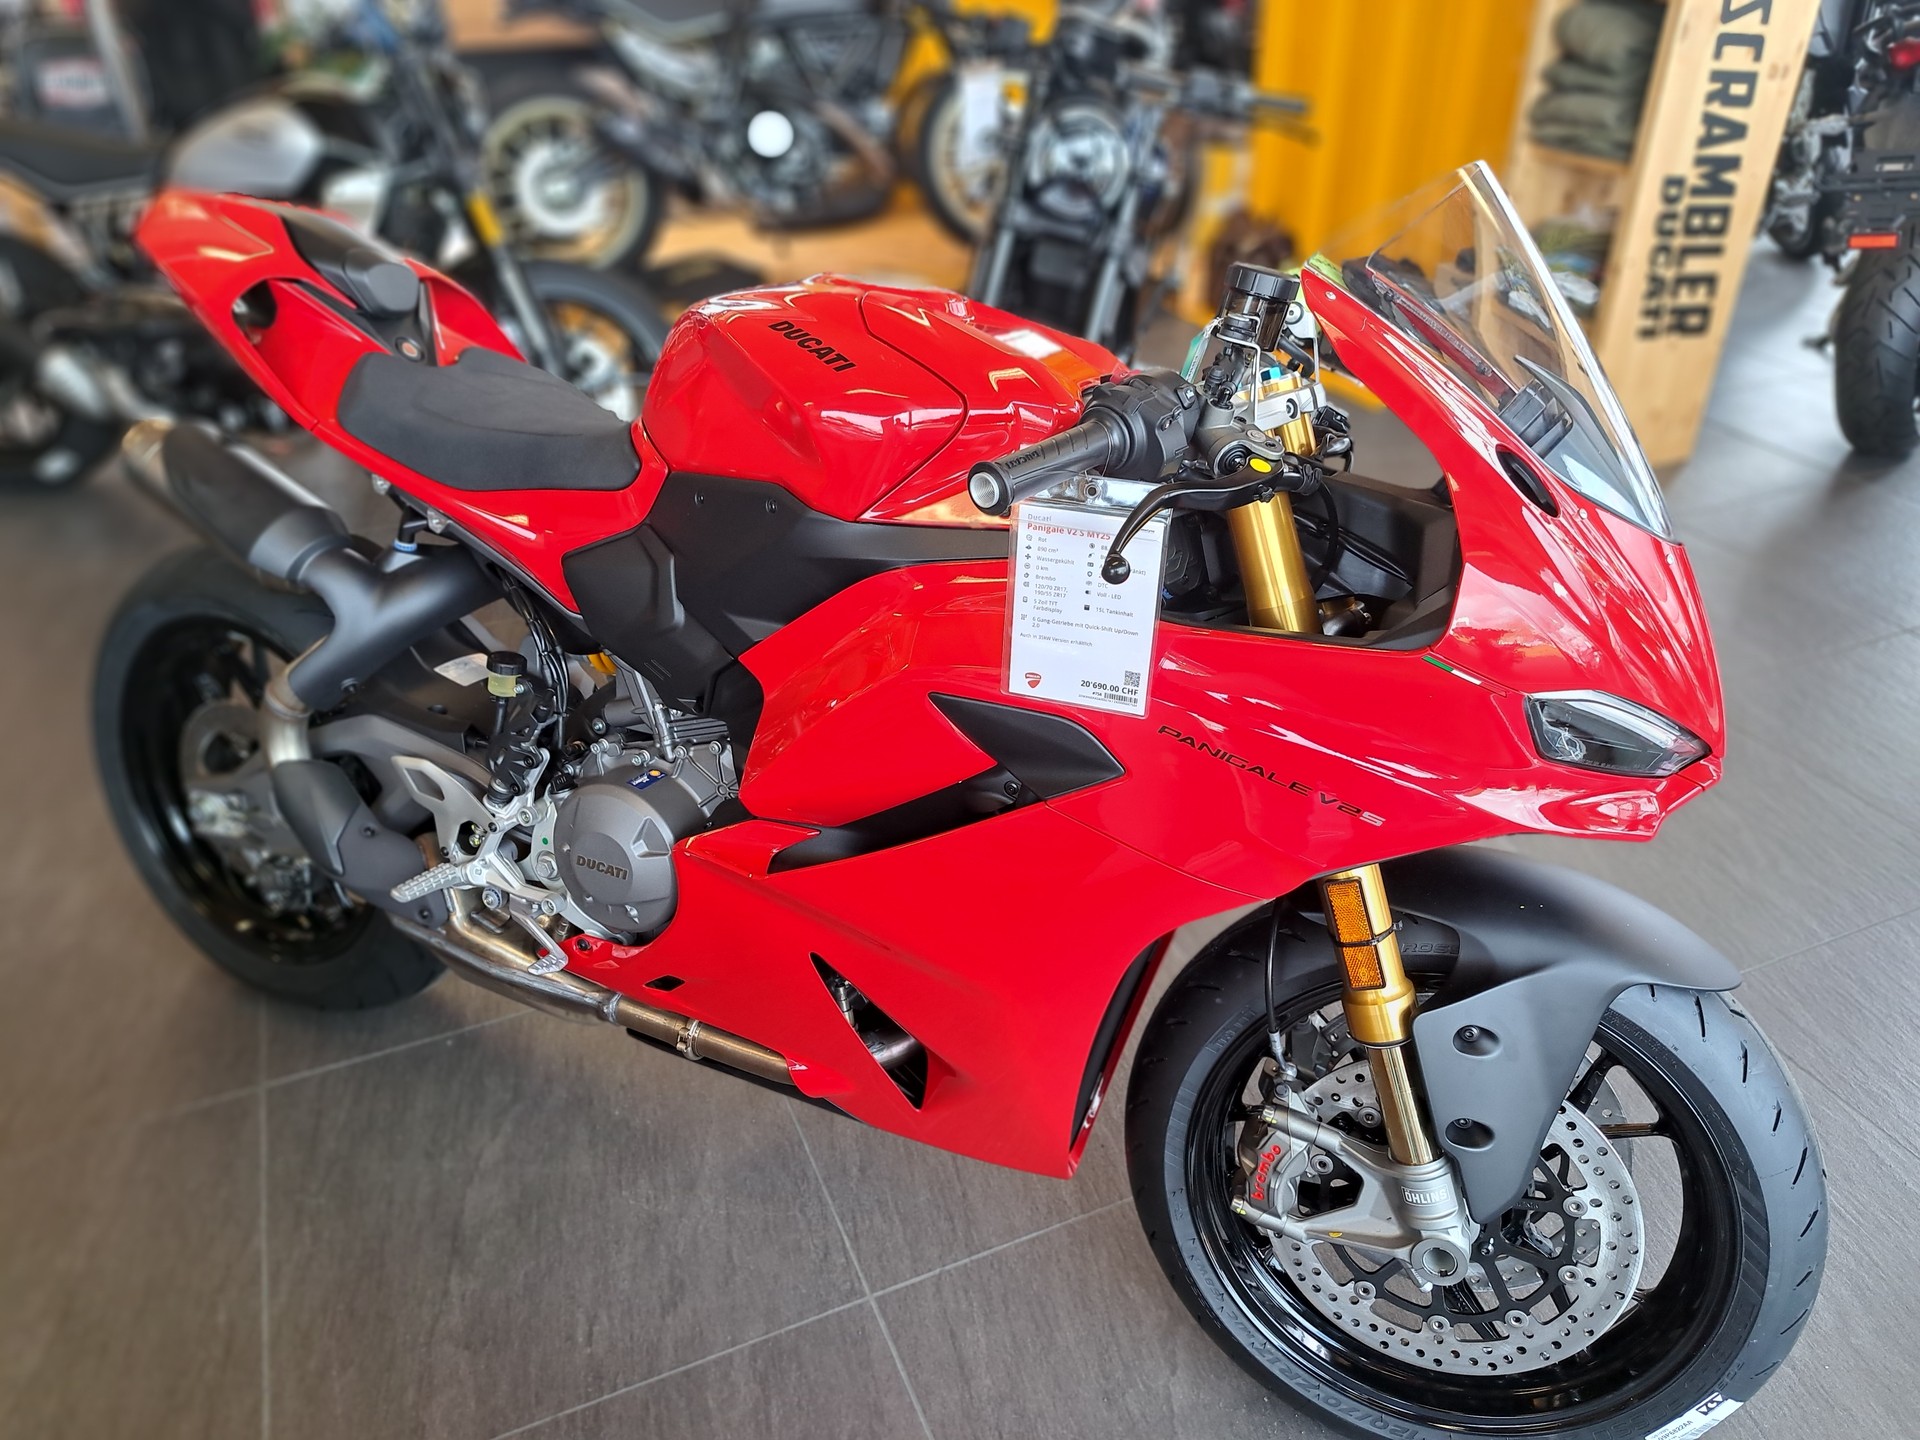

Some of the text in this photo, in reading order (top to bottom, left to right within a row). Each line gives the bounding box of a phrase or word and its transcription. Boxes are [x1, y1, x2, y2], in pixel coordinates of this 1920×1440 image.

[1668, 0, 1773, 338] SCRAMBLER
[1637, 175, 1686, 340] DUCATI
[768, 321, 857, 372] DUCATI
[1005, 450, 1041, 470] DUCATI
[1028, 513, 1052, 522] Ducati
[1027, 522, 1065, 535] Panigale
[1087, 531, 1111, 540] MY25
[1036, 555, 1075, 565] Wassergekühlt
[1035, 583, 1068, 593] 120/70 ZR17,
[1033, 605, 1063, 614] Farbdisplay
[1106, 608, 1134, 618] Tankinhalt
[1037, 617, 1074, 627] Gang-Getriebe
[1084, 623, 1113, 633] Quick-Shift
[1113, 628, 1139, 637] Up/Down
[1070, 639, 1093, 647] erhältlich
[1080, 679, 1139, 696] 20'690.00 CHF
[1158, 725, 1313, 797] PANIGALE
[576, 855, 629, 880] DUCATI
[1251, 1145, 1281, 1200] brembo
[1404, 1188, 1447, 1204] ÖHLINS
